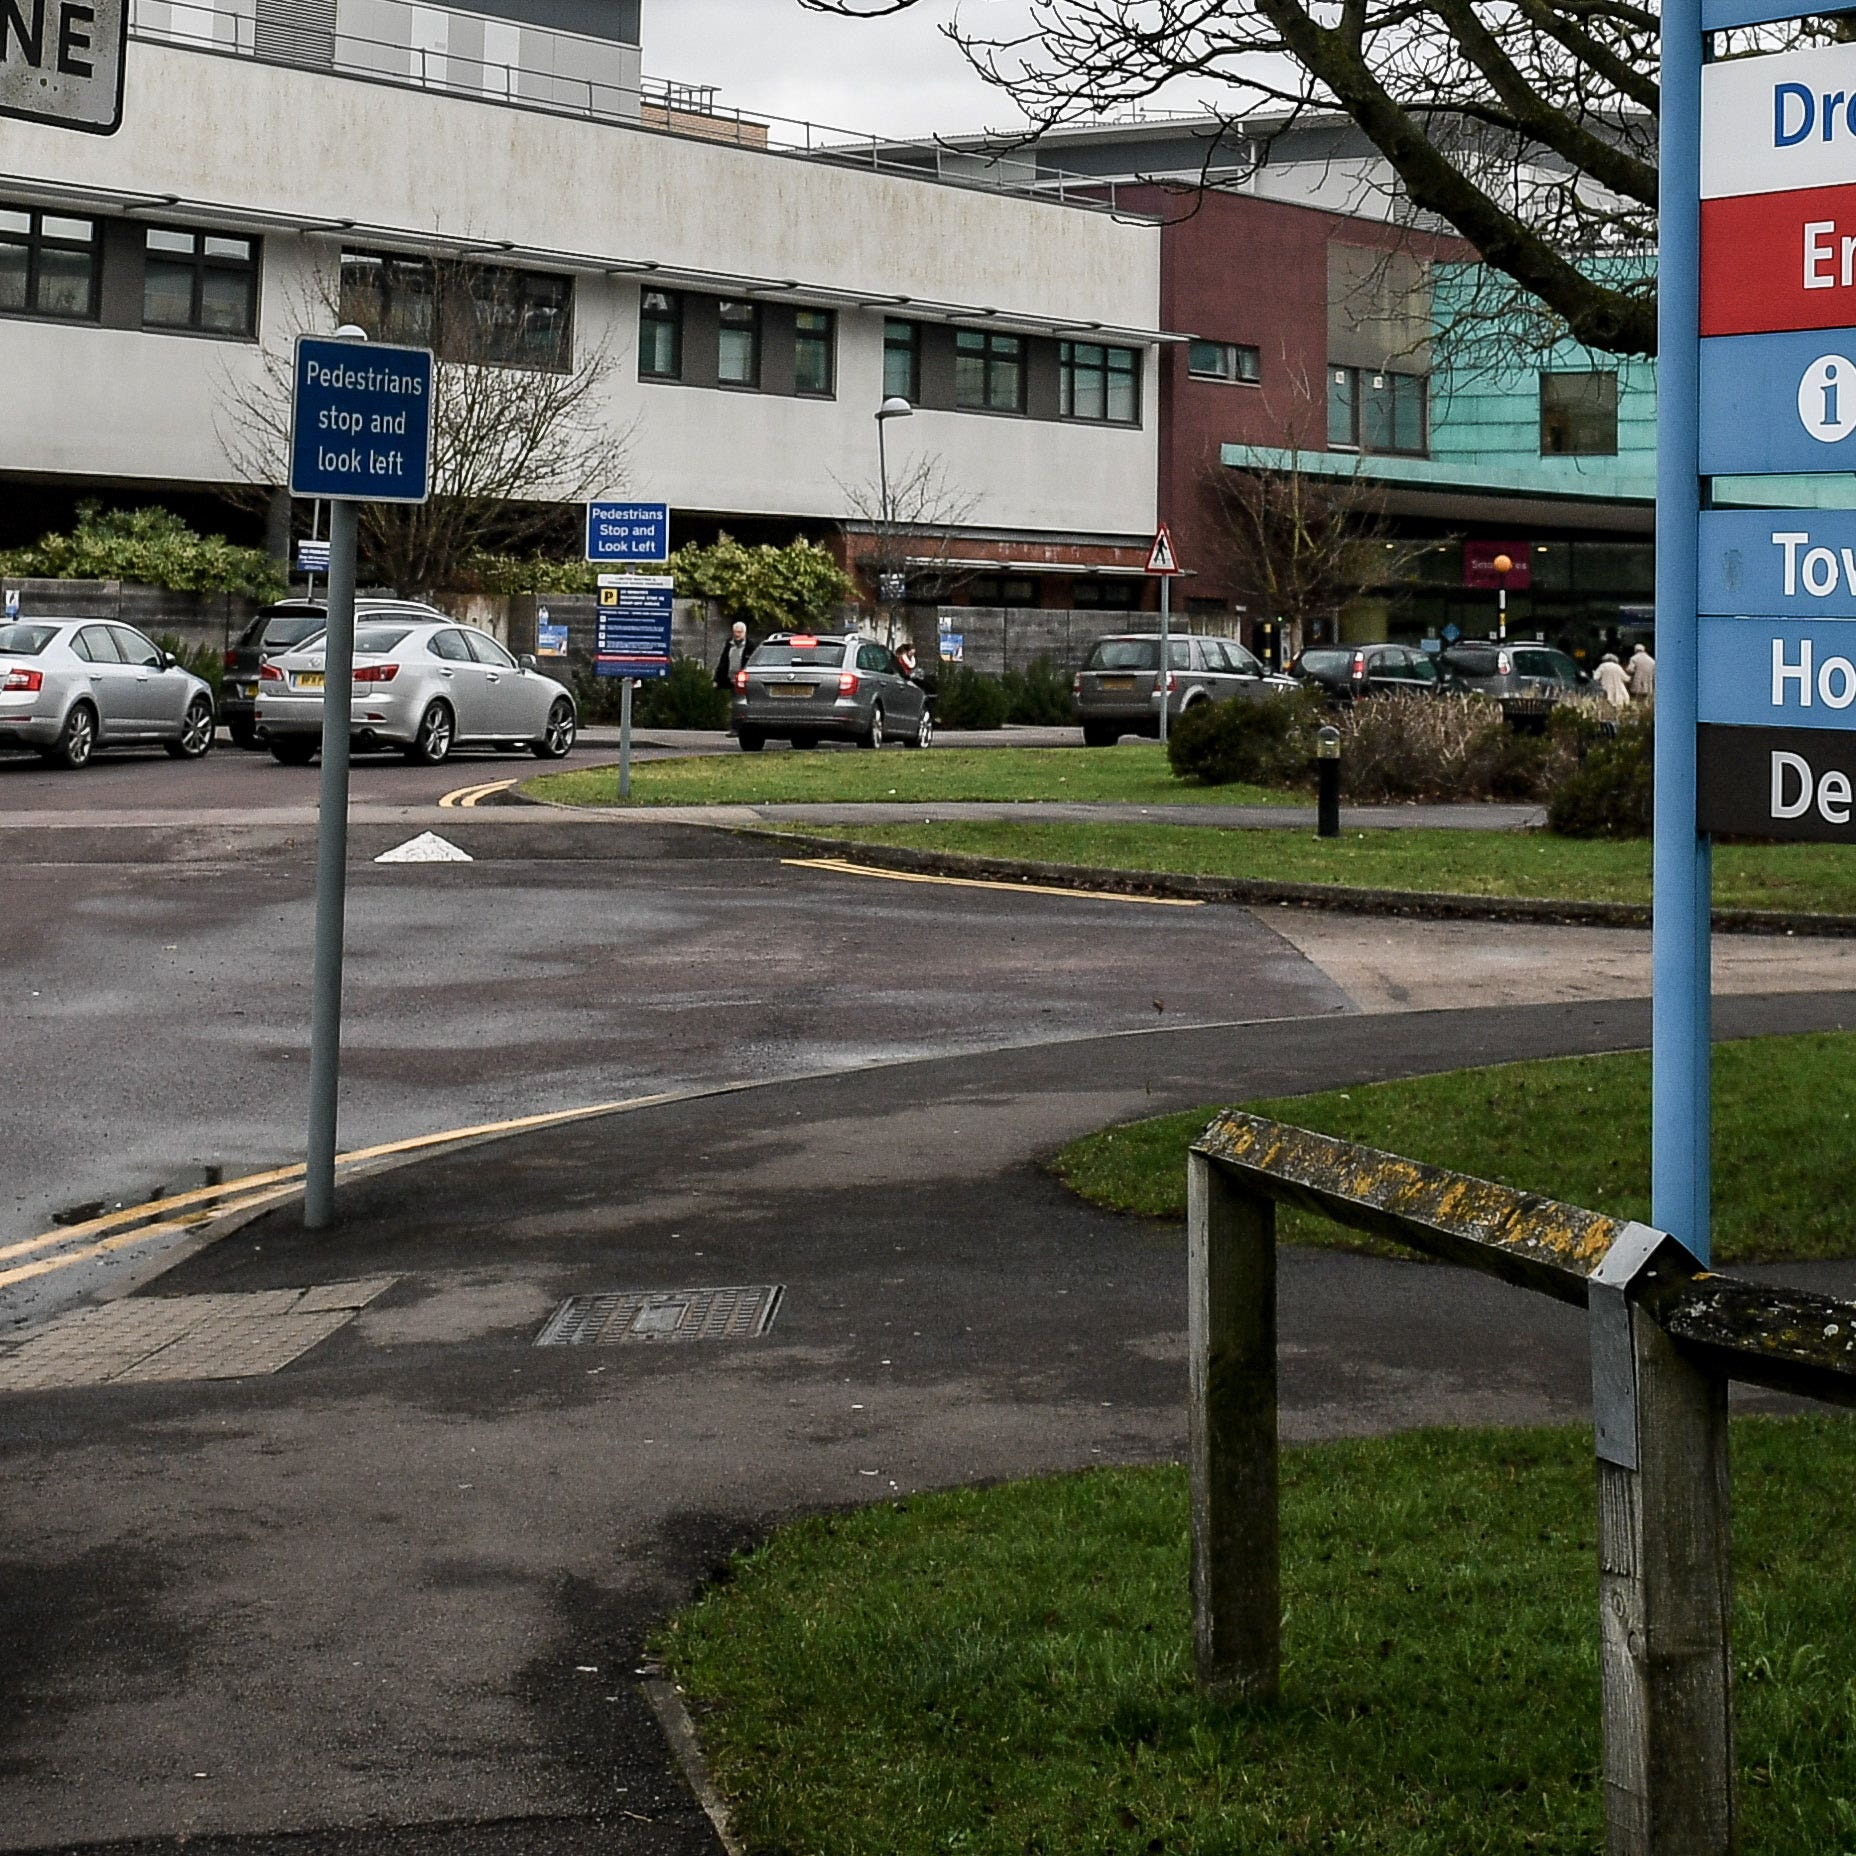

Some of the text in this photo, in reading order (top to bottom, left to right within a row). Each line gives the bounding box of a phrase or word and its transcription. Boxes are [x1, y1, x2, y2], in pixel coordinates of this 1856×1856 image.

[307, 361, 422, 395] Pedestrians
[318, 405, 405, 436] stop and
[318, 446, 404, 476] look left
[593, 508, 663, 520] Pedestrians
[599, 524, 655, 537] Stop and
[598, 541, 656, 552] Look Left
